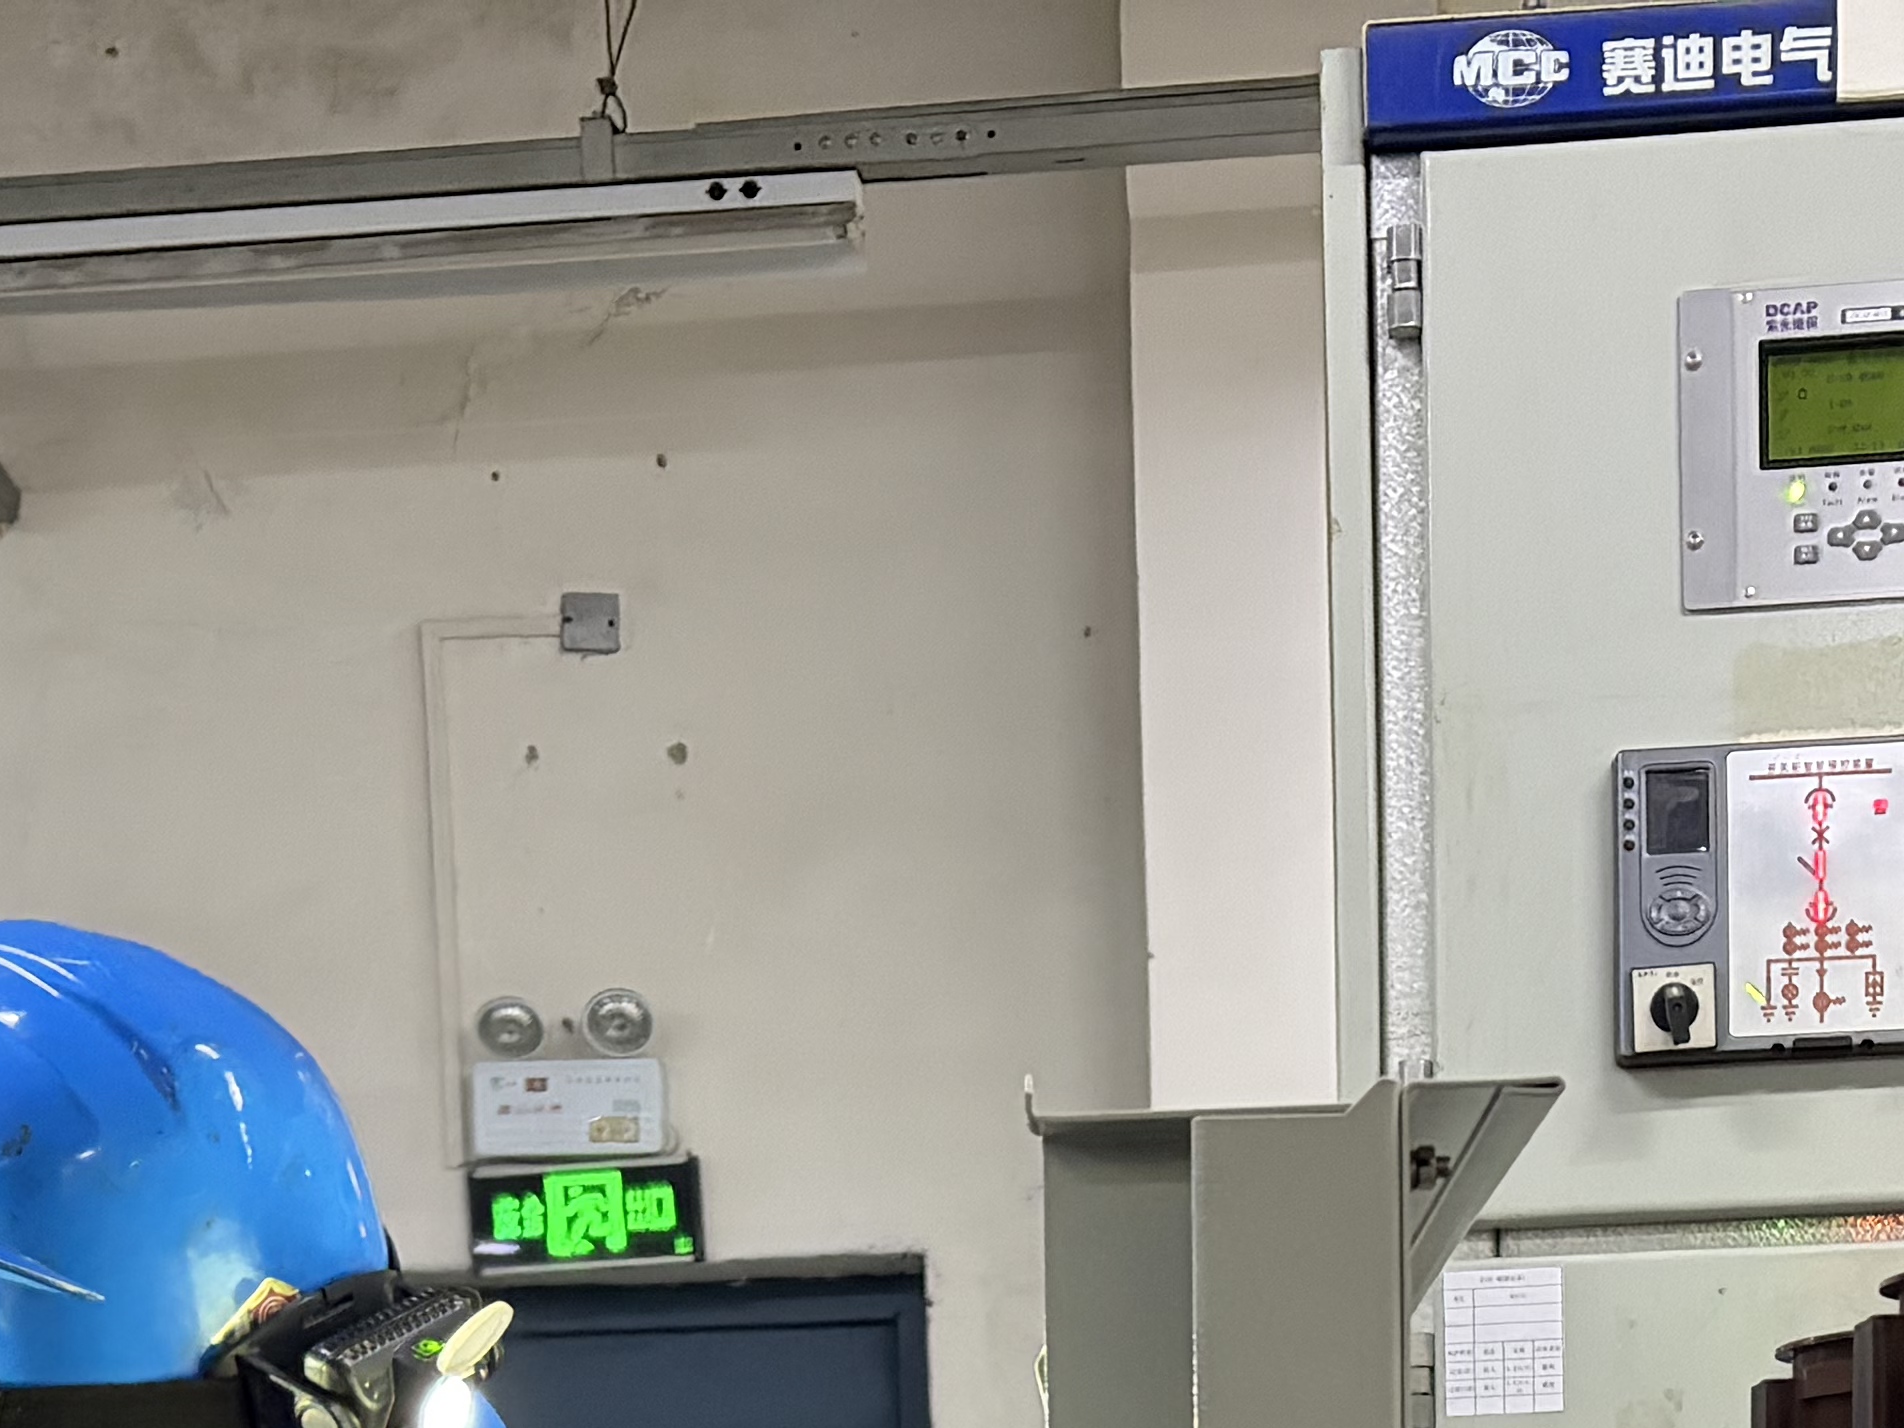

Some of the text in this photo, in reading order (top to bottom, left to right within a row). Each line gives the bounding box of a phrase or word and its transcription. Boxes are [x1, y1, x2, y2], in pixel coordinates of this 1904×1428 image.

[1453, 49, 1570, 87] MCC
[1601, 25, 1833, 97] 赛迪电气
[1765, 301, 1819, 317] DCAP
